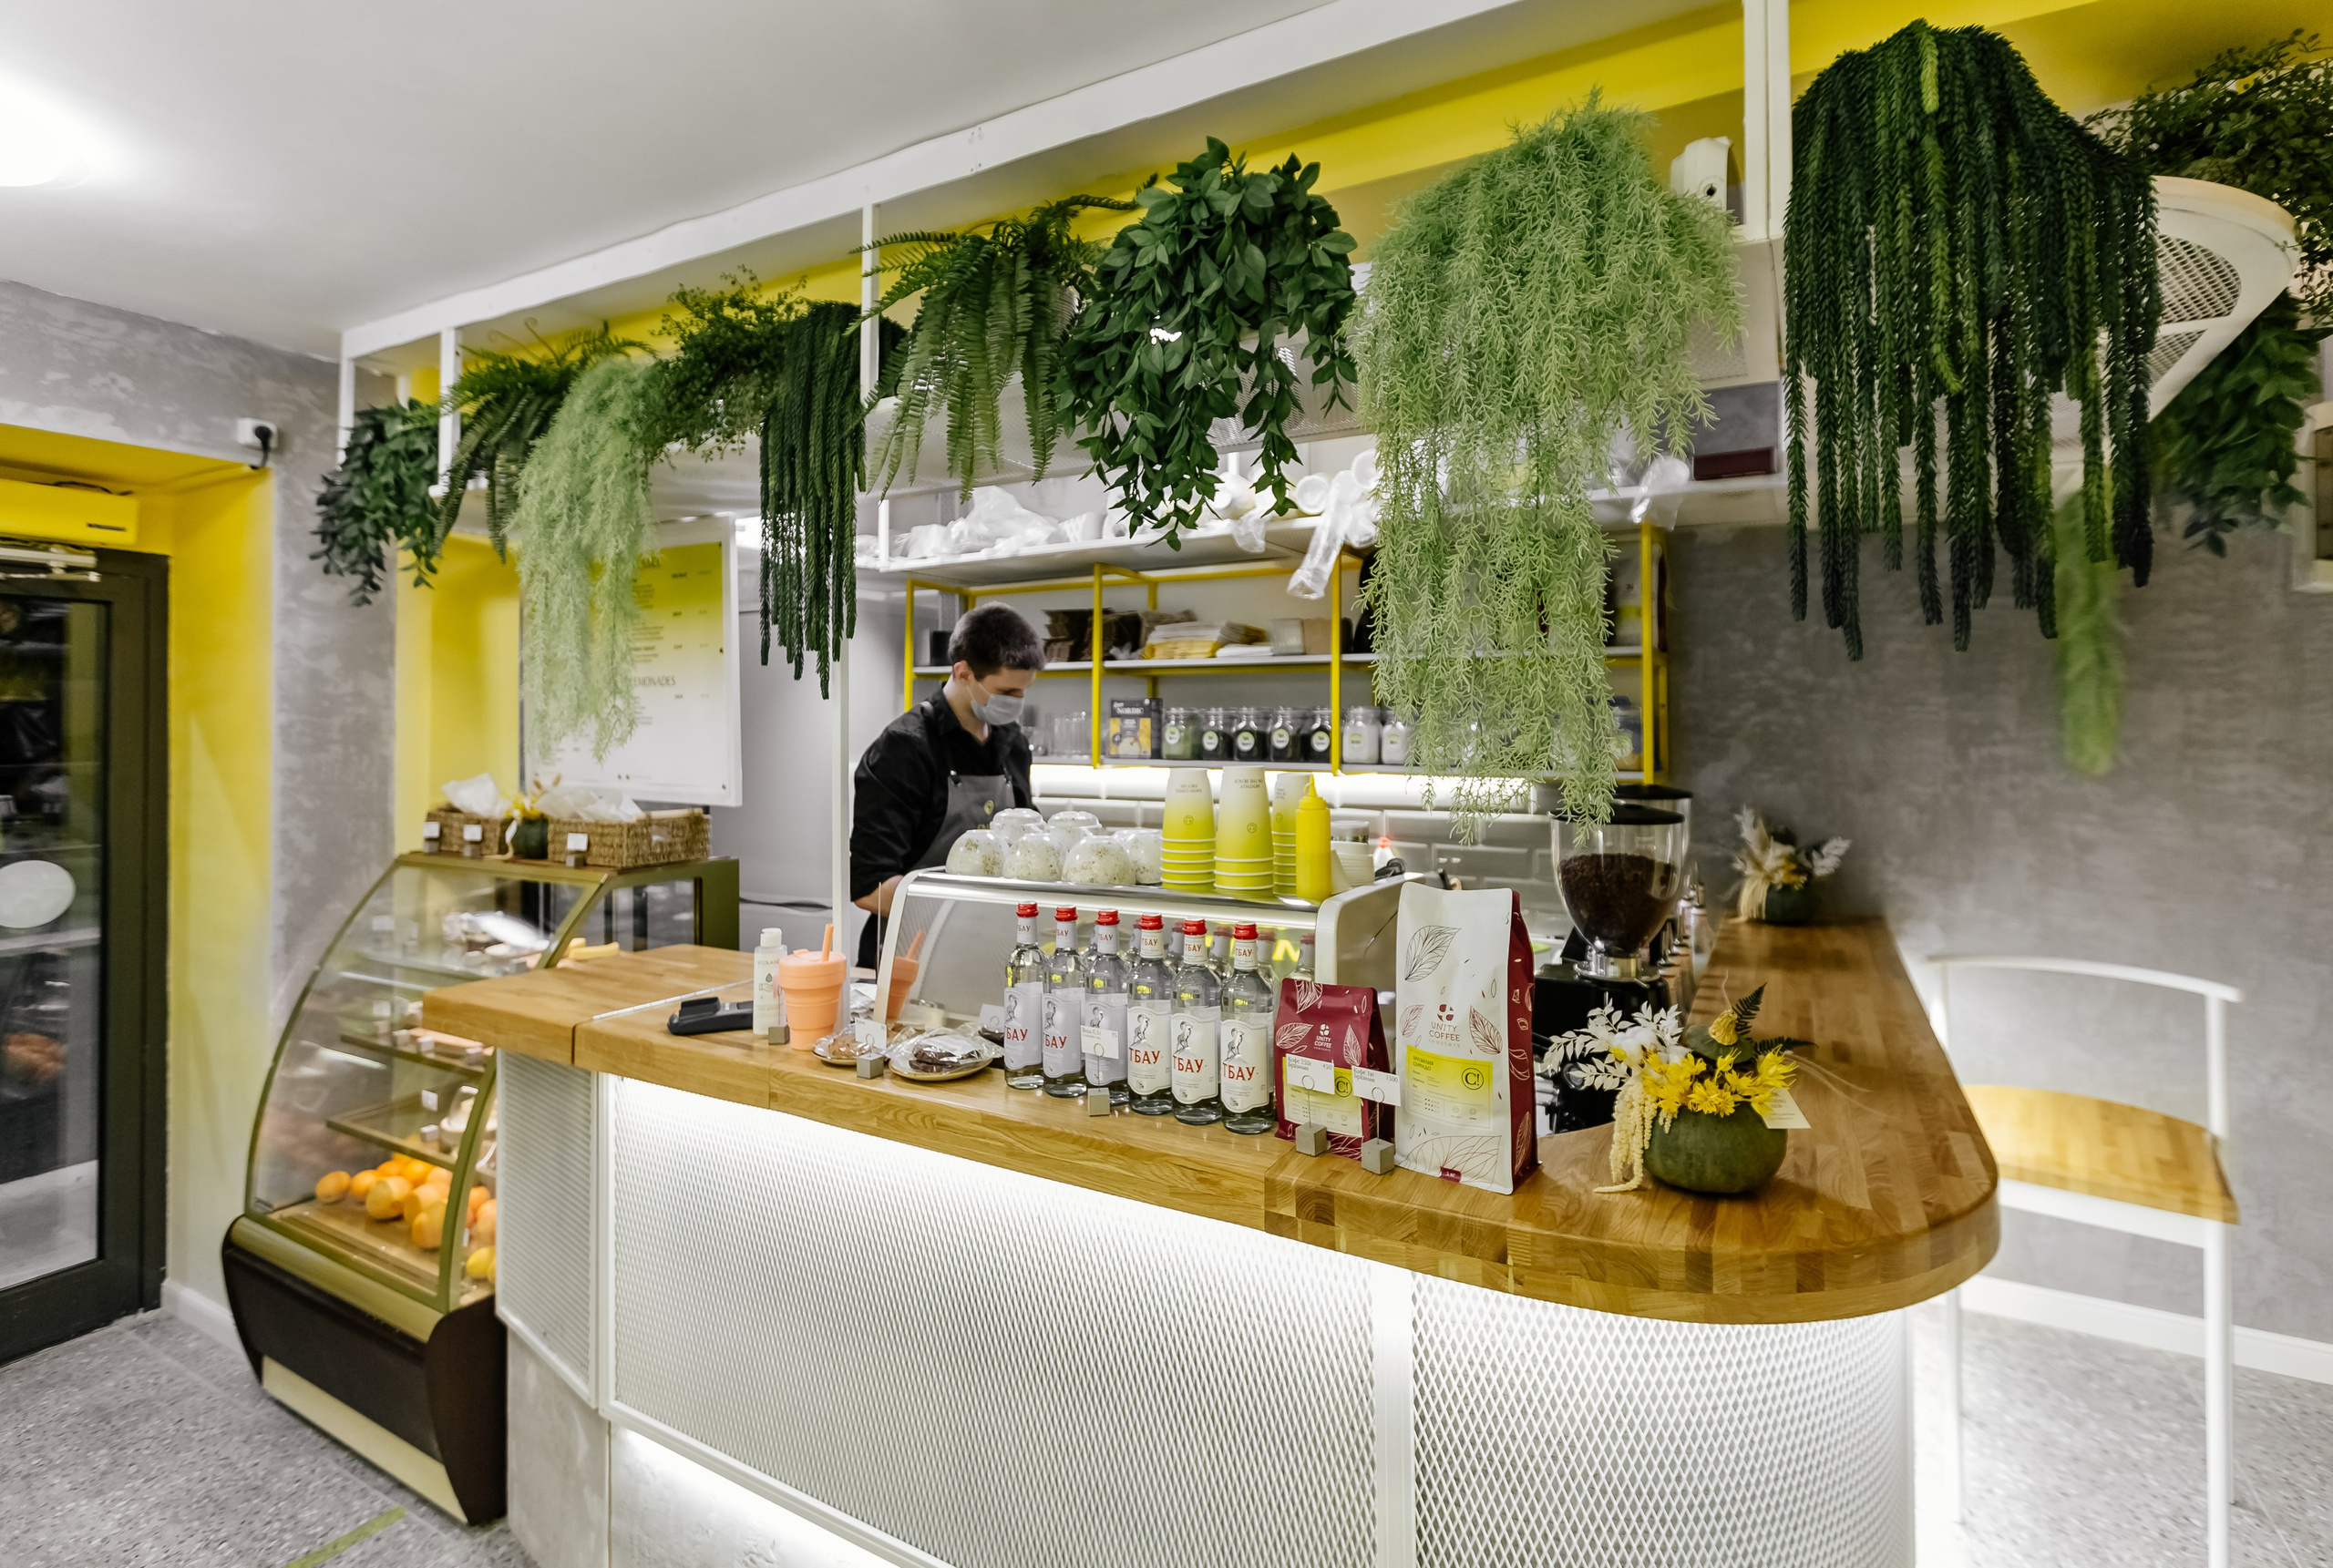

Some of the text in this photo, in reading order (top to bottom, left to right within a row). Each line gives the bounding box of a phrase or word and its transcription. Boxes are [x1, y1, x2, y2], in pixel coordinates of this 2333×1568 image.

[1142, 938, 1158, 947] ТБАУ
[1185, 943, 1202, 952] ТБАУ
[1235, 948, 1252, 958] ТБАУ
[1431, 1021, 1457, 1031] UNITY
[1005, 1026, 1028, 1042] БАУ
[1429, 1030, 1461, 1041] COFFEE
[1043, 1033, 1067, 1049] БАУ
[1429, 1039, 1461, 1047] roasters
[1129, 1047, 1160, 1065] ТБАУ
[1288, 1057, 1300, 1066] Кофе
[1173, 1054, 1204, 1073] ТБАУ
[1222, 1062, 1256, 1081] ТБАУ
[1353, 1069, 1366, 1077] Кофе
[1386, 1075, 1398, 1083] 1500
